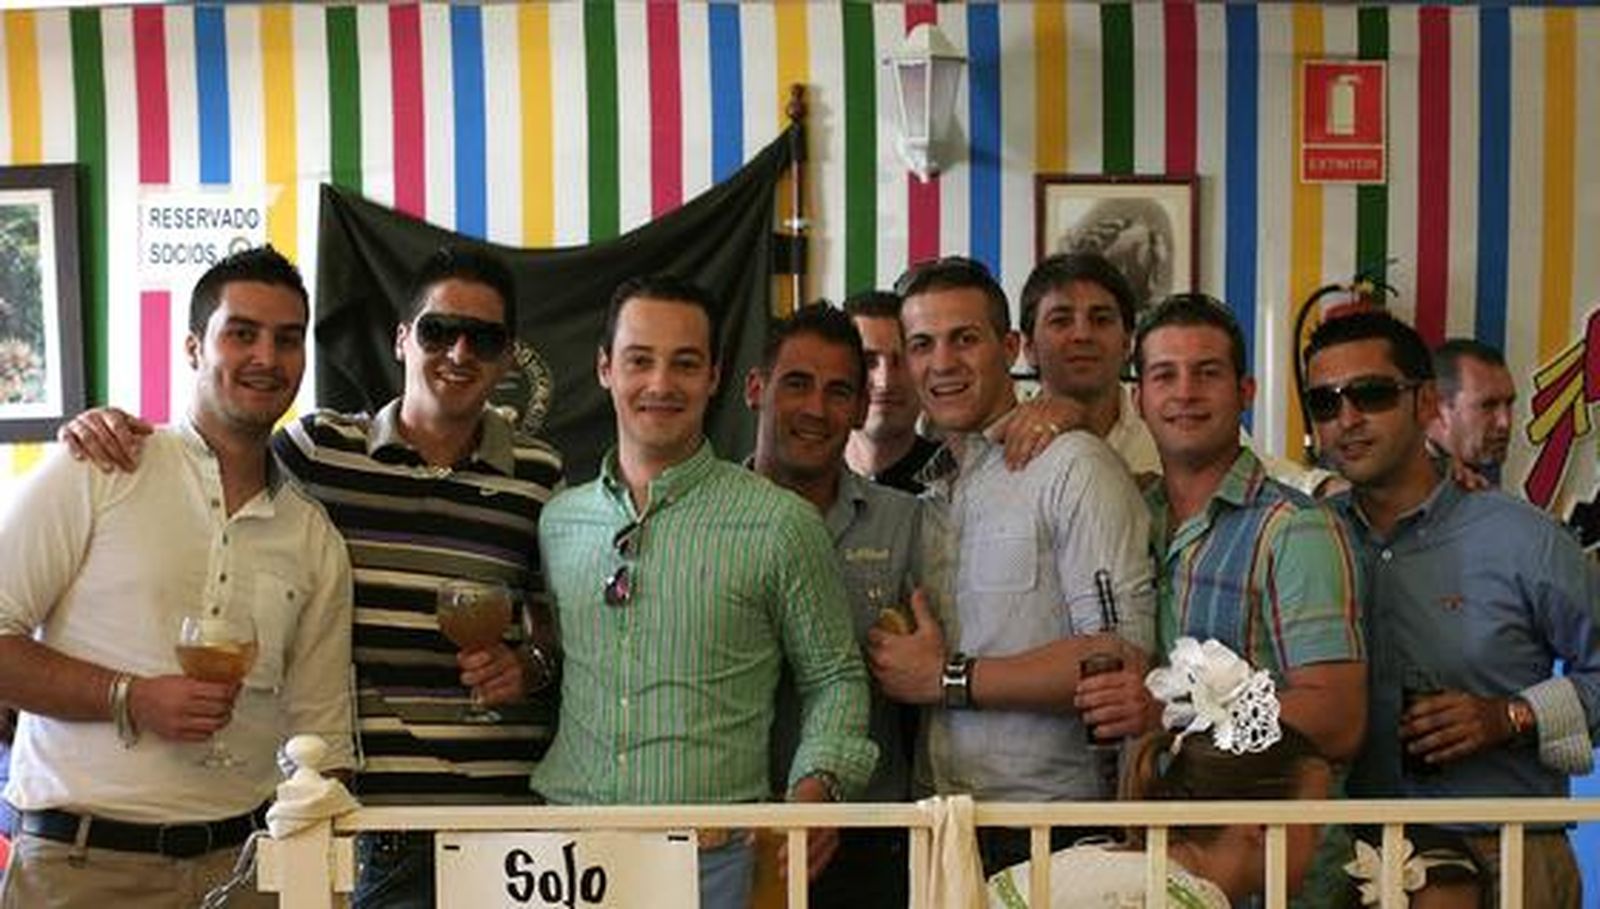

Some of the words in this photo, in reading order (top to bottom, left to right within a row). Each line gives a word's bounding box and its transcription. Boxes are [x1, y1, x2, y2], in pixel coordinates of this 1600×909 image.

[149, 207, 261, 230] RESERVADO
[149, 242, 218, 266] SOCIOS
[504, 841, 607, 909] Solo
